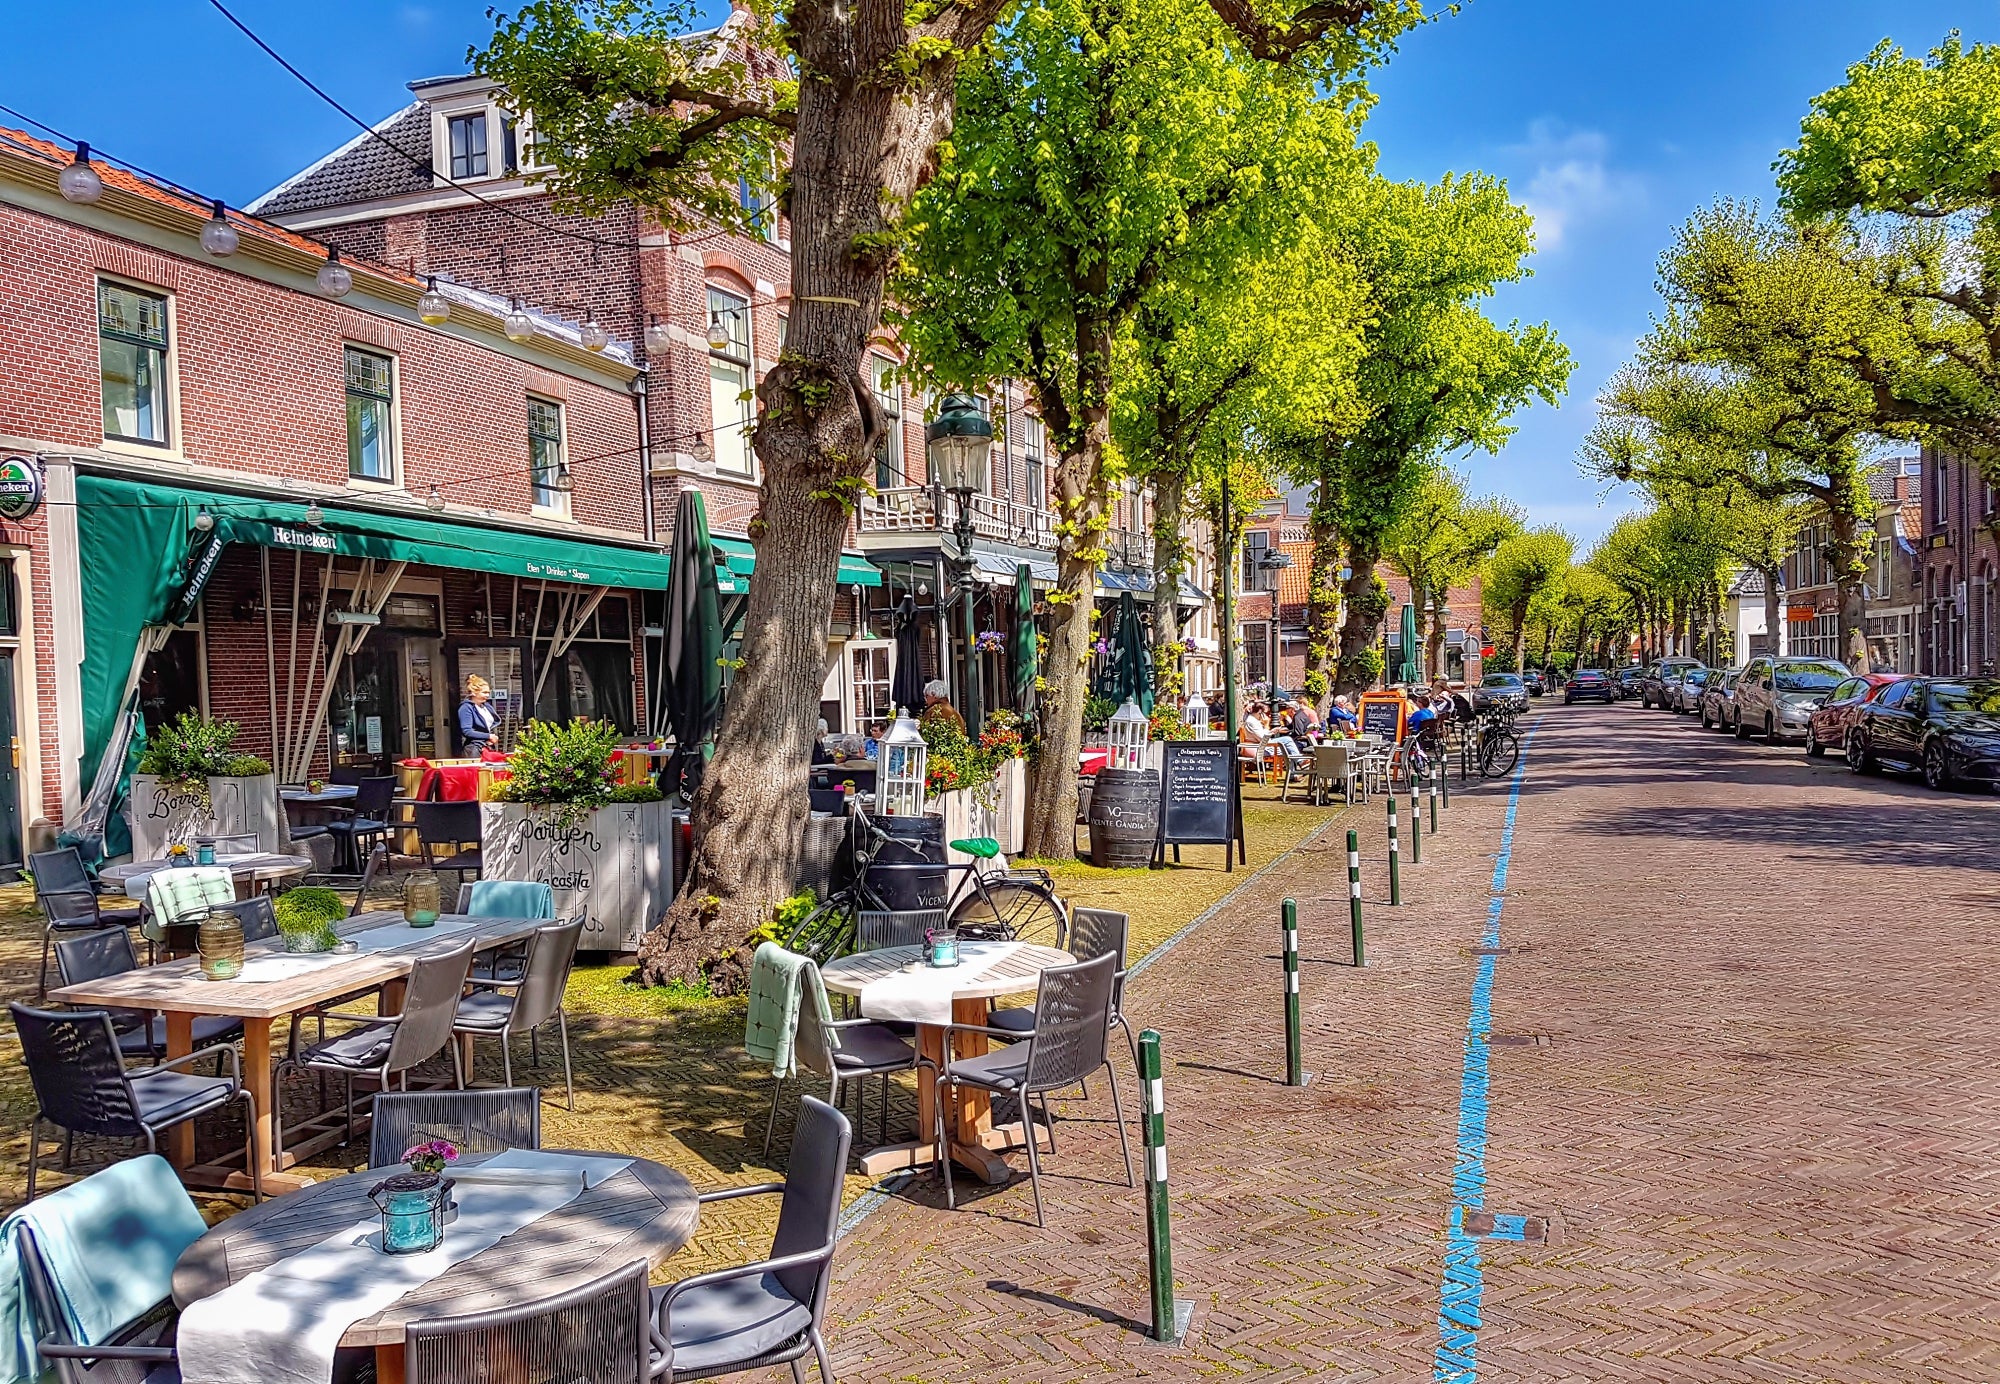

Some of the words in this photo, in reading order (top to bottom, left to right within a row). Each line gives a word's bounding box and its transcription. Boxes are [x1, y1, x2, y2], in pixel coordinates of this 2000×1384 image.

[272, 526, 337, 549] Heineken
[182, 537, 223, 606] Heineken
[527, 562, 540, 573] Eten
[546, 565, 567, 577] Drinken
[572, 568, 590, 580] Slapen
